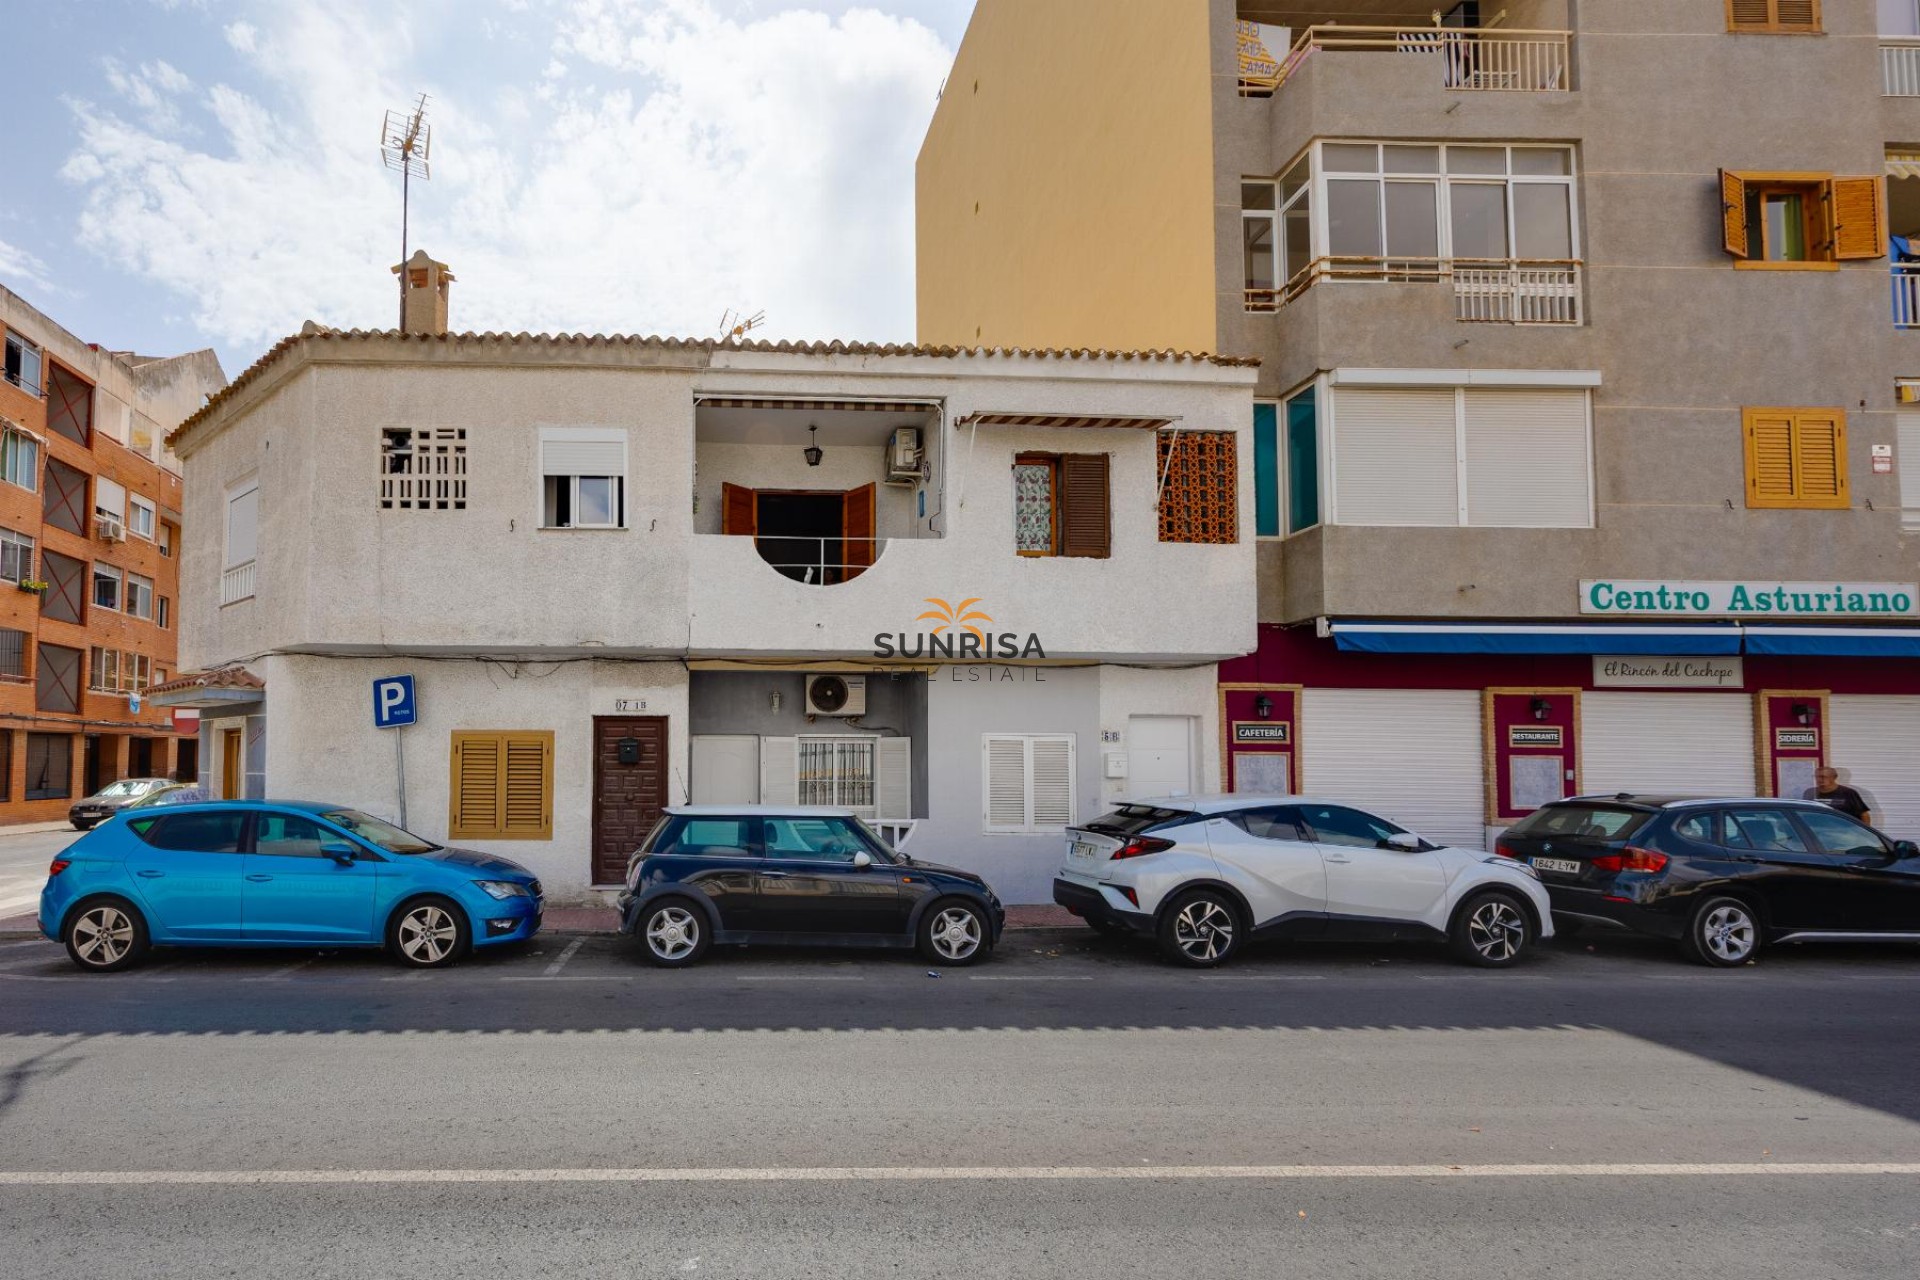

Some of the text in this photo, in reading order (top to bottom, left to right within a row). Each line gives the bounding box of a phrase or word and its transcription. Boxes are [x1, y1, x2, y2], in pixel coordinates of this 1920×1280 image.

[1589, 582, 1911, 613] Centro Asturiano
[1604, 660, 1733, 685] El Rincón del Cachopo
[380, 682, 405, 721] P
[1238, 728, 1284, 738] CAFETERÍA
[1778, 733, 1814, 743] SIDRERÍA
